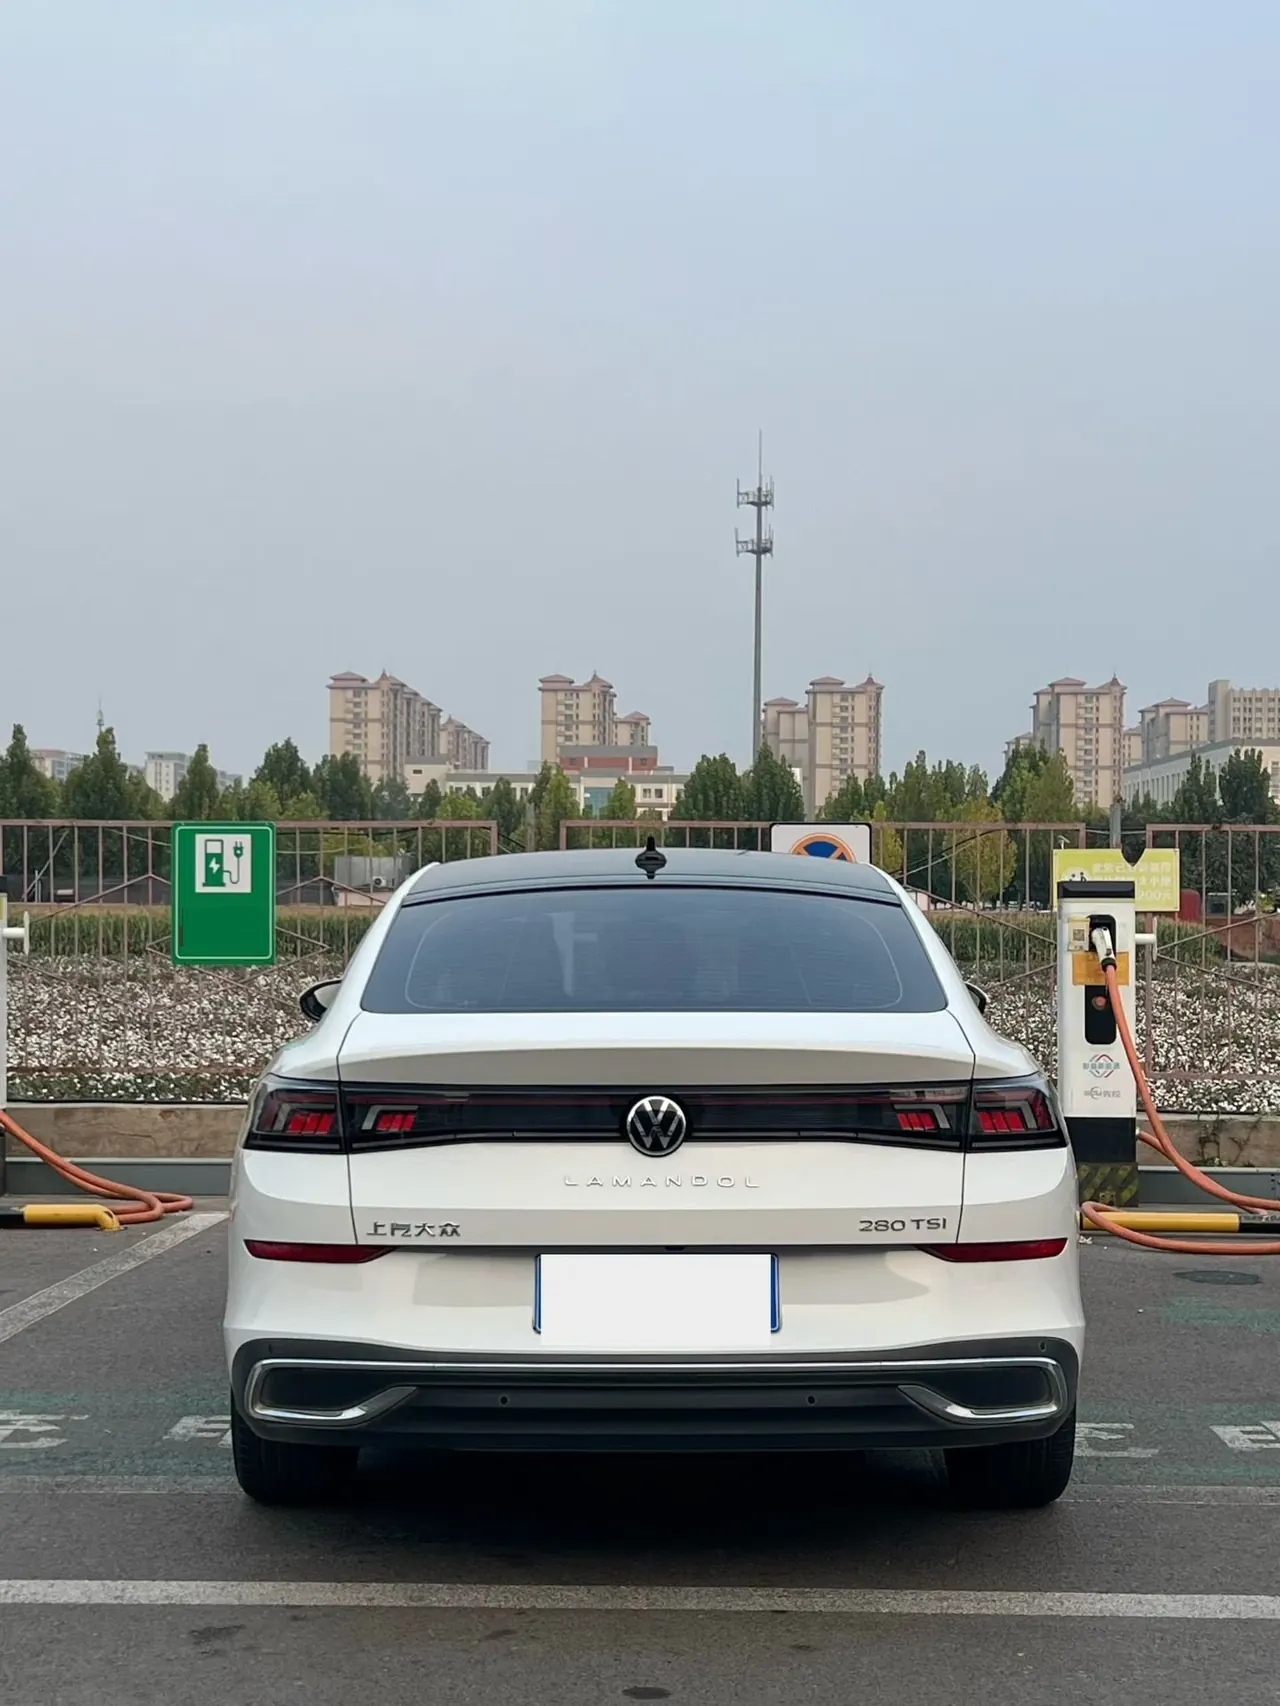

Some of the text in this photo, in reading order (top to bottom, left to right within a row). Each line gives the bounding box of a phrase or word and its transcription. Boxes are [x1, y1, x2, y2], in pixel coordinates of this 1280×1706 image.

[563, 1175, 760, 1189] LAMANDOL
[366, 1221, 461, 1237] 上汽大众
[859, 1217, 947, 1232] 280 TSI
